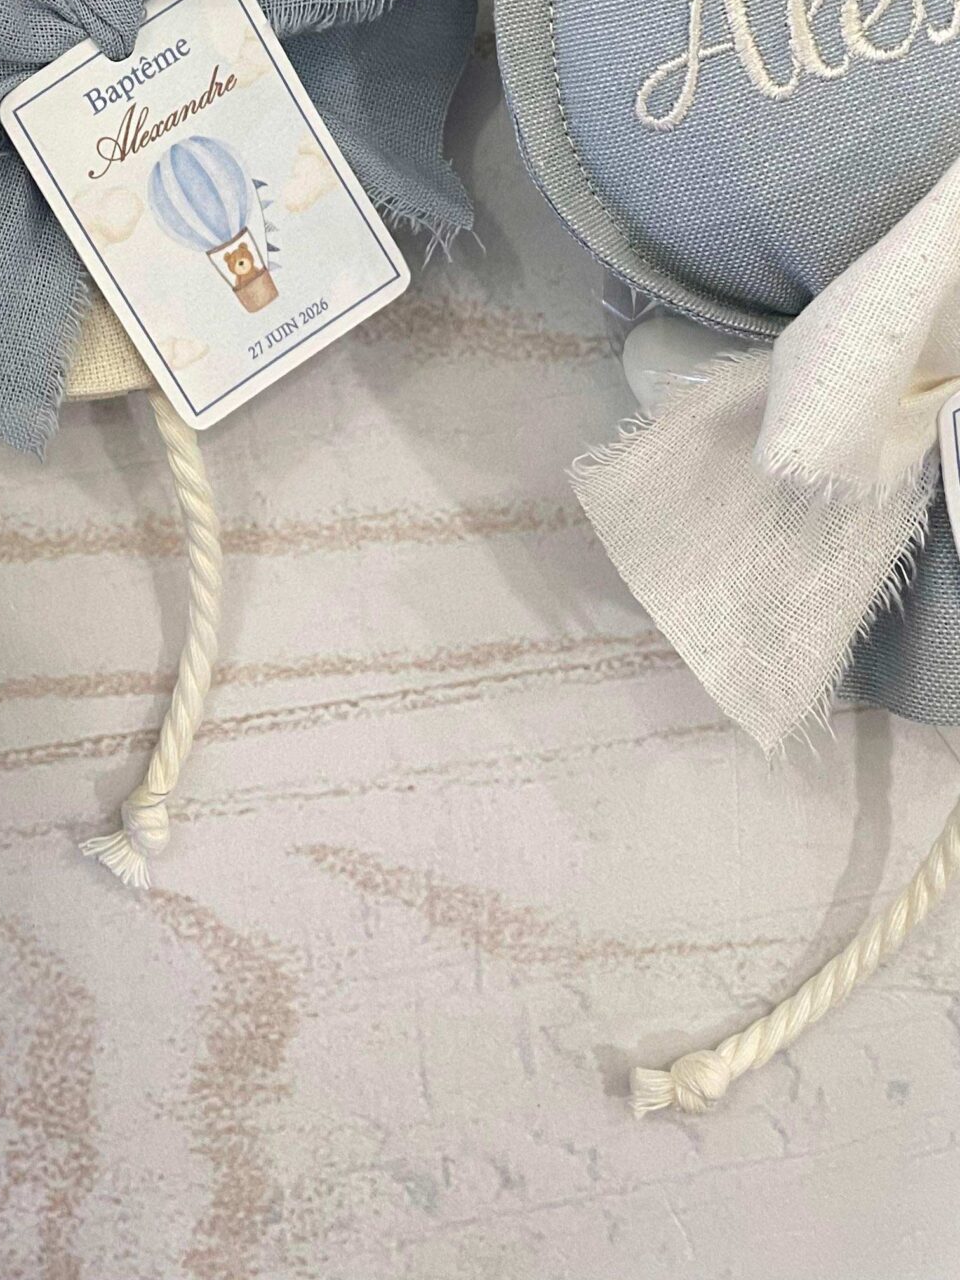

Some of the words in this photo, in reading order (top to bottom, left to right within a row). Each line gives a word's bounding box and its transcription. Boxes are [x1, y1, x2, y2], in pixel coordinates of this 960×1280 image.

[82, 37, 191, 116] Baptême
[87, 64, 238, 180] Alexandre
[247, 340, 264, 360] 27
[264, 317, 300, 349] JUIN
[298, 297, 329, 325] 2026
